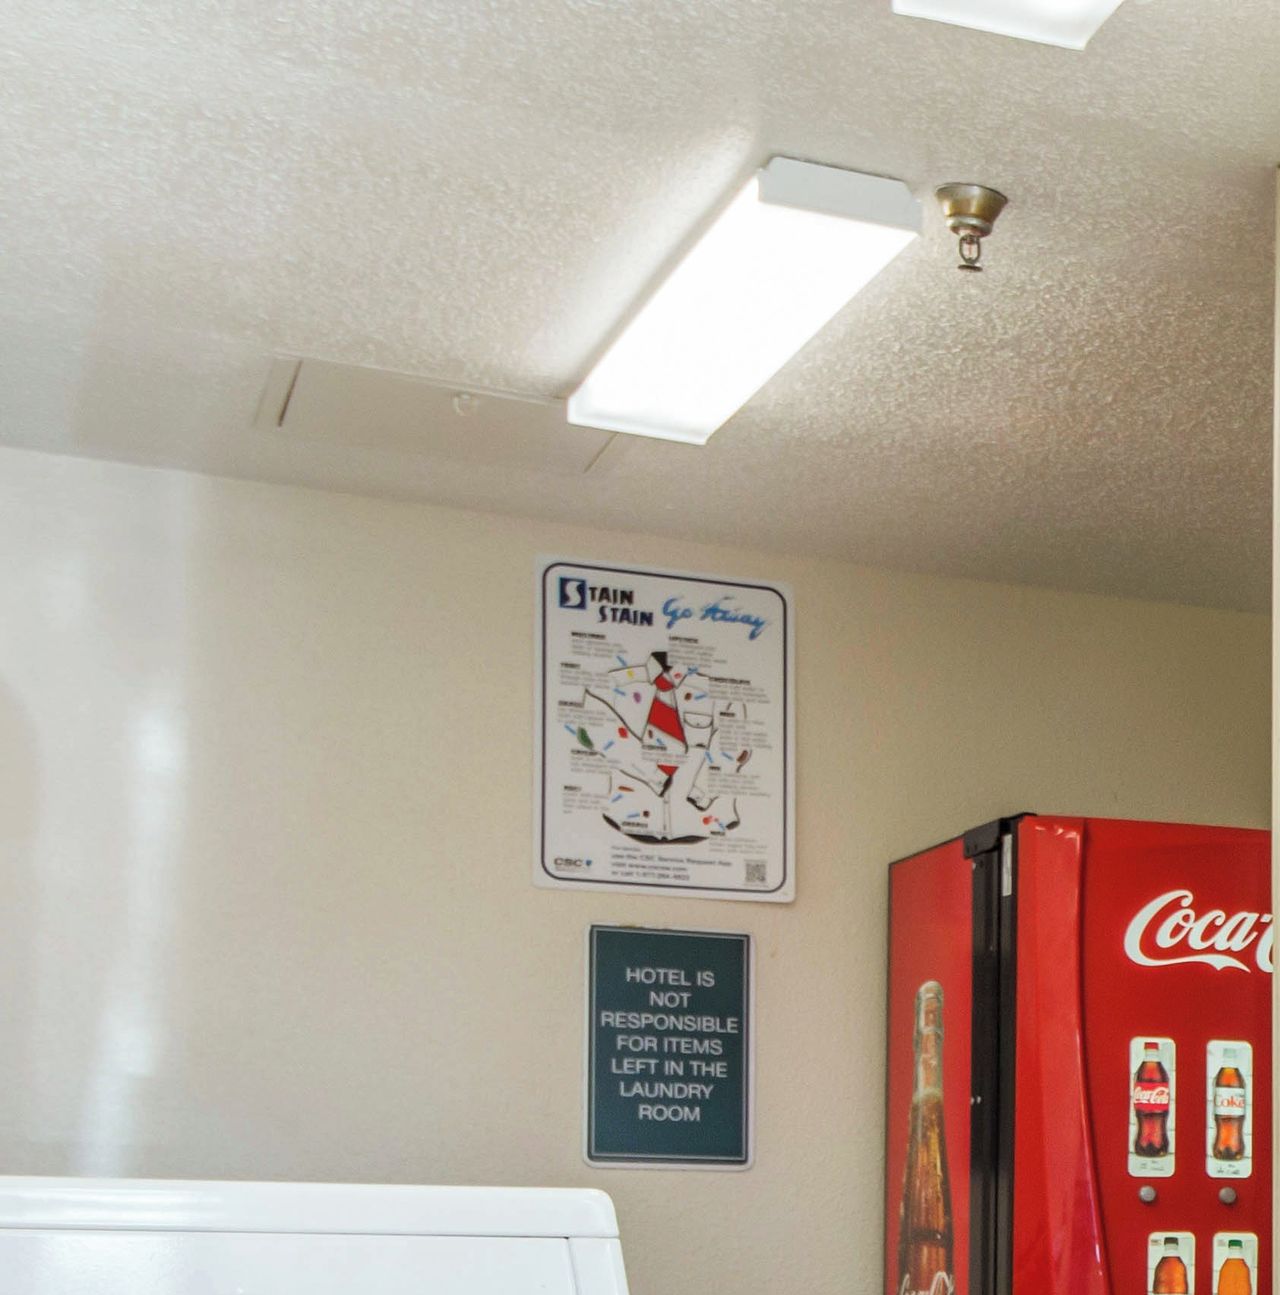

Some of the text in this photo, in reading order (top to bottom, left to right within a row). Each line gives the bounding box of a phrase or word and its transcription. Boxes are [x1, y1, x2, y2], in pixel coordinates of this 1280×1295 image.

[562, 578, 634, 609] STAIN
[599, 596, 769, 640] STAIN Go Away
[1124, 889, 1273, 973] Coca-
[626, 967, 715, 988] HOTEL IS
[649, 991, 692, 1008] NOT
[601, 1011, 739, 1034] RESPONSIBLE
[616, 1034, 723, 1056] FOR ITEMS
[611, 1057, 728, 1078] LEFT IN THE
[619, 1081, 714, 1100] LAUNDRY
[638, 1104, 700, 1122] ROOM
